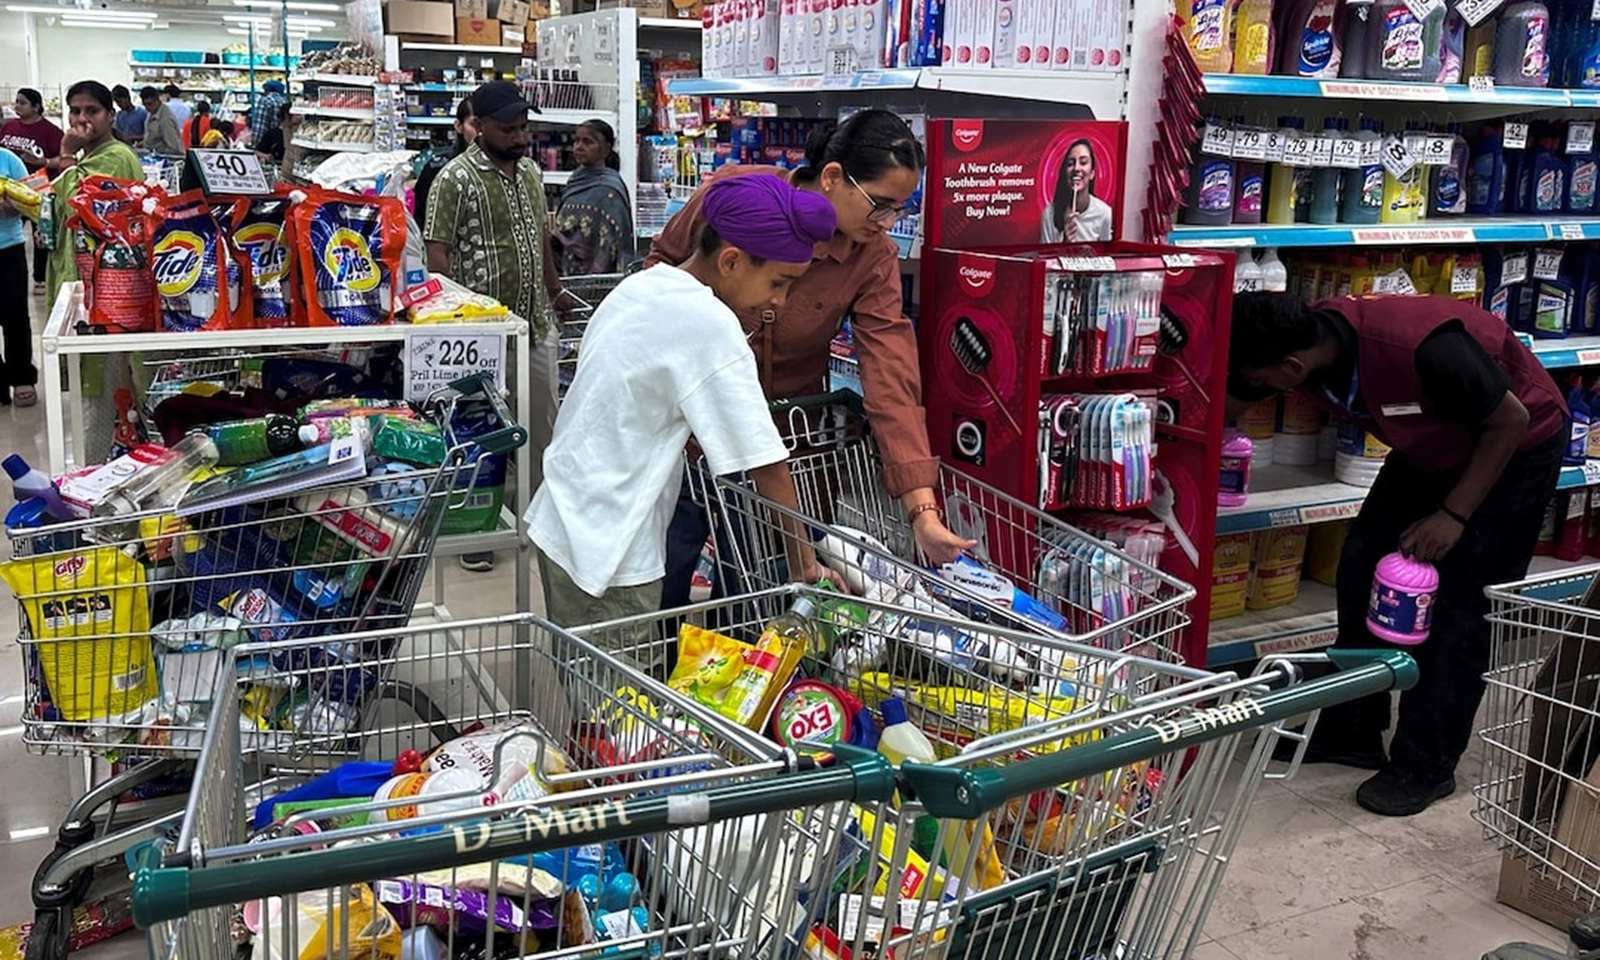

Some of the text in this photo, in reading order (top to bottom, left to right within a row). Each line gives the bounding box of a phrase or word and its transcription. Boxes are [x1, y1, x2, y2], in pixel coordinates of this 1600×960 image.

[955, 128, 979, 138] Colgate
[1243, 132, 1259, 146] 79
[1292, 139, 1307, 153] 79
[1341, 141, 1355, 155] 79
[1432, 140, 1444, 153] 8
[216, 154, 247, 176] 40
[958, 163, 1022, 176] A New Colgate
[944, 177, 1035, 187] Toothbrush removes
[953, 191, 1025, 203] 5x more plaque.
[965, 205, 1010, 219] Buy Now!
[152, 248, 200, 278] Tide
[959, 265, 993, 279] Colgate
[439, 340, 478, 366] 226
[411, 370, 429, 380] Pril
[433, 370, 459, 380] Lime
[55, 556, 86, 576] Giffy
[953, 574, 1002, 592] Panasonic
[791, 704, 833, 739] EXO
[1149, 698, 1264, 743] D Mart
[453, 801, 632, 853] D Mart
